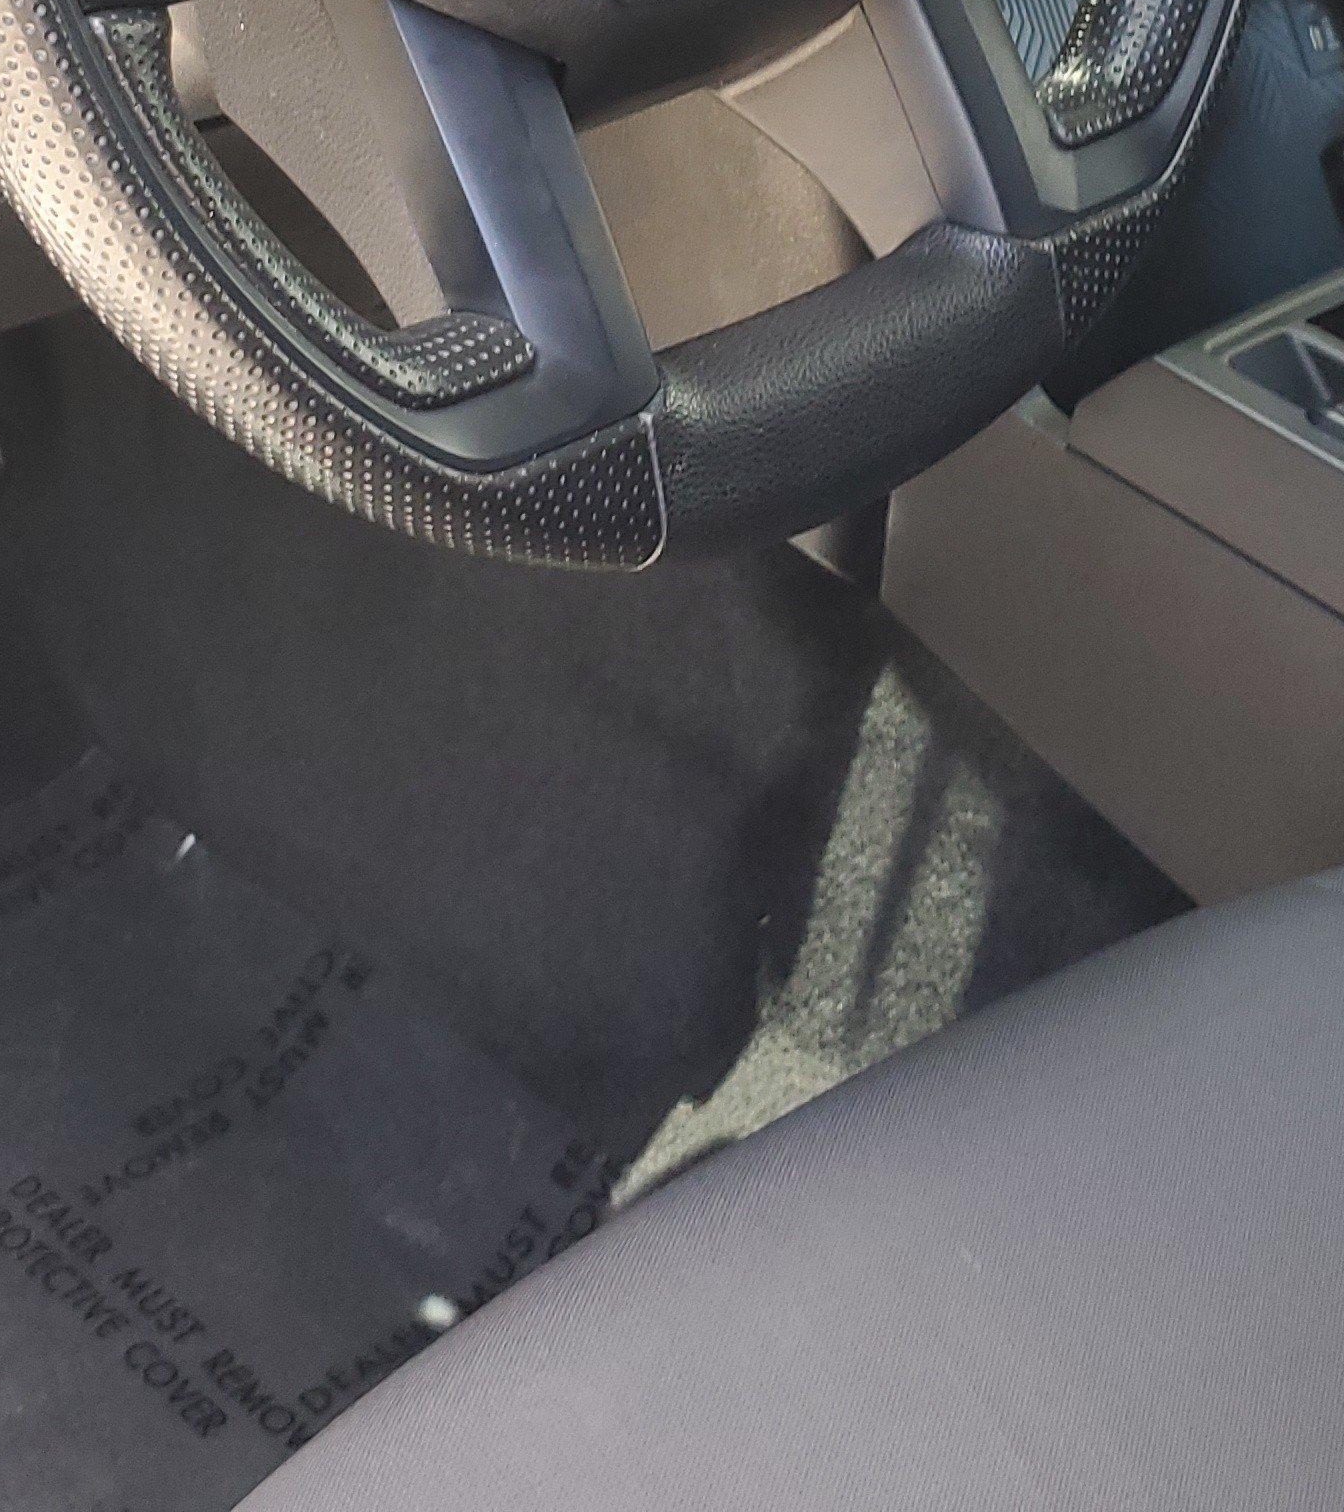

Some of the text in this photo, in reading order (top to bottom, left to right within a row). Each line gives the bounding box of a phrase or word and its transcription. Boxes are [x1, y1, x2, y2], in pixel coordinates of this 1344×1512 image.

[9, 1174, 310, 1449] DEALER MUST REMOV
[123, 1340, 229, 1439] COVER
